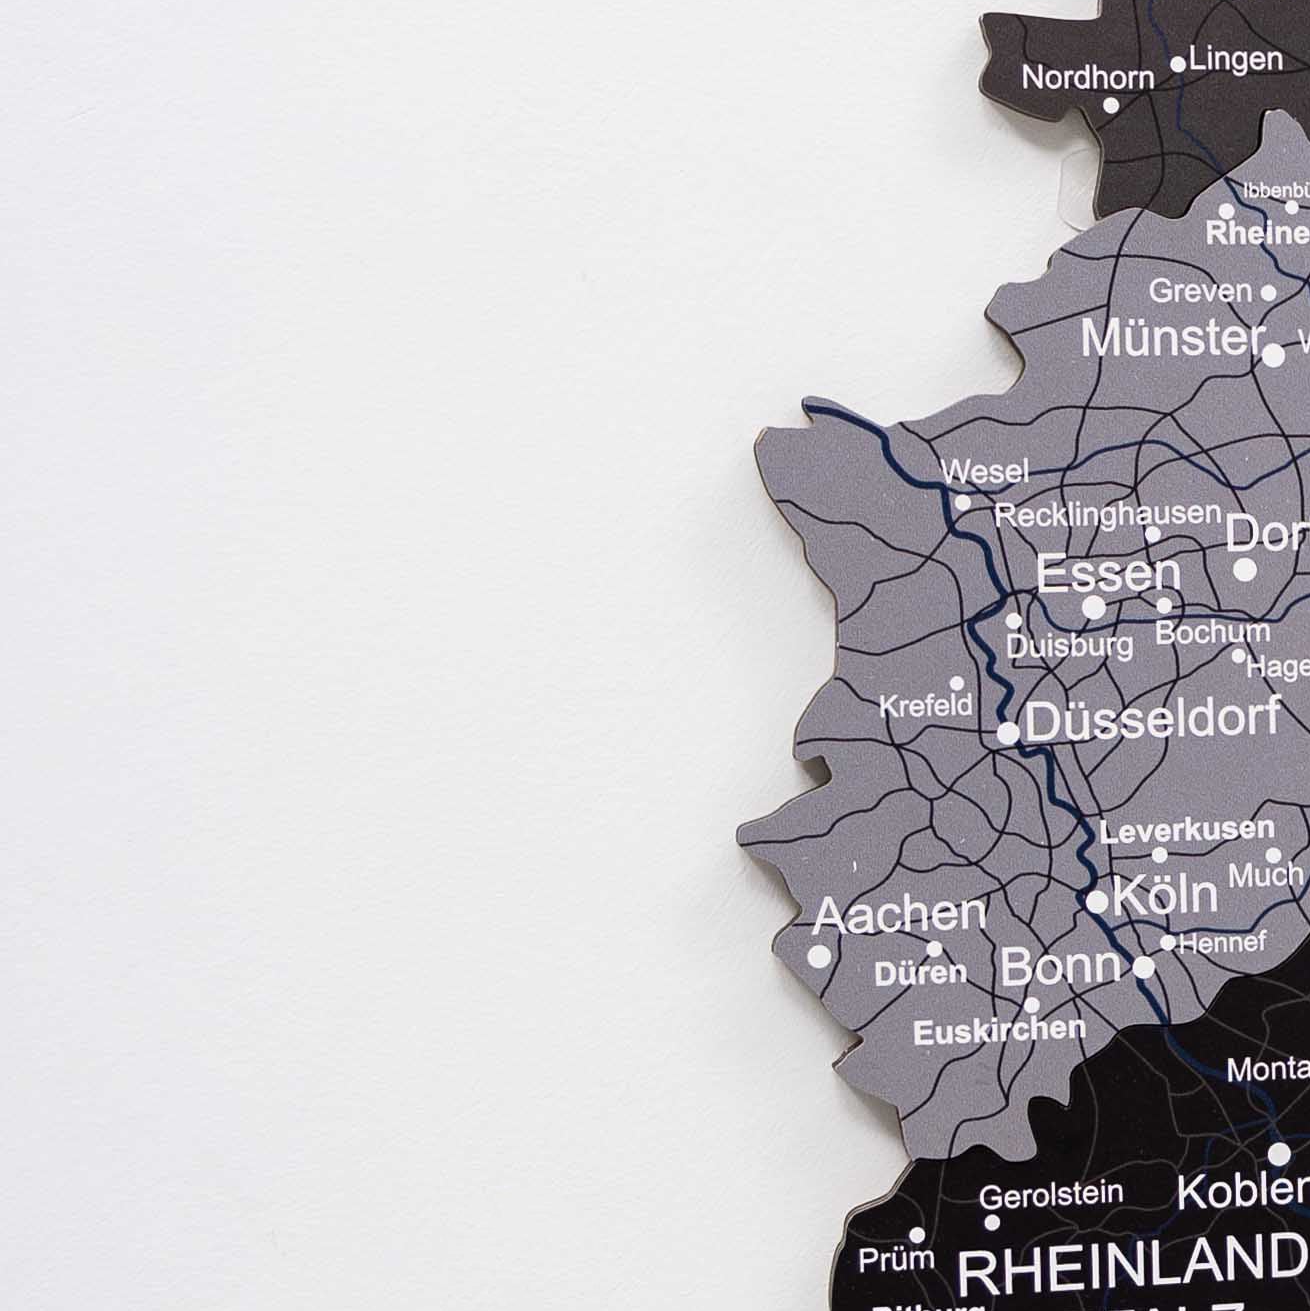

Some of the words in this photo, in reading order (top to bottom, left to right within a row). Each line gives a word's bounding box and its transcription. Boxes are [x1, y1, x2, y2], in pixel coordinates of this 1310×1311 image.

[1023, 64, 1154, 89] Nordhorn
[1083, 318, 1266, 356] Münster
[1038, 553, 1180, 593] Essen
[1027, 694, 1282, 741] Düsseldorf
[1114, 873, 1217, 915] Köln
[812, 893, 985, 935] Aachen
[914, 1015, 1086, 1045] Euskirchen
[860, 1246, 934, 1272] Prüm
